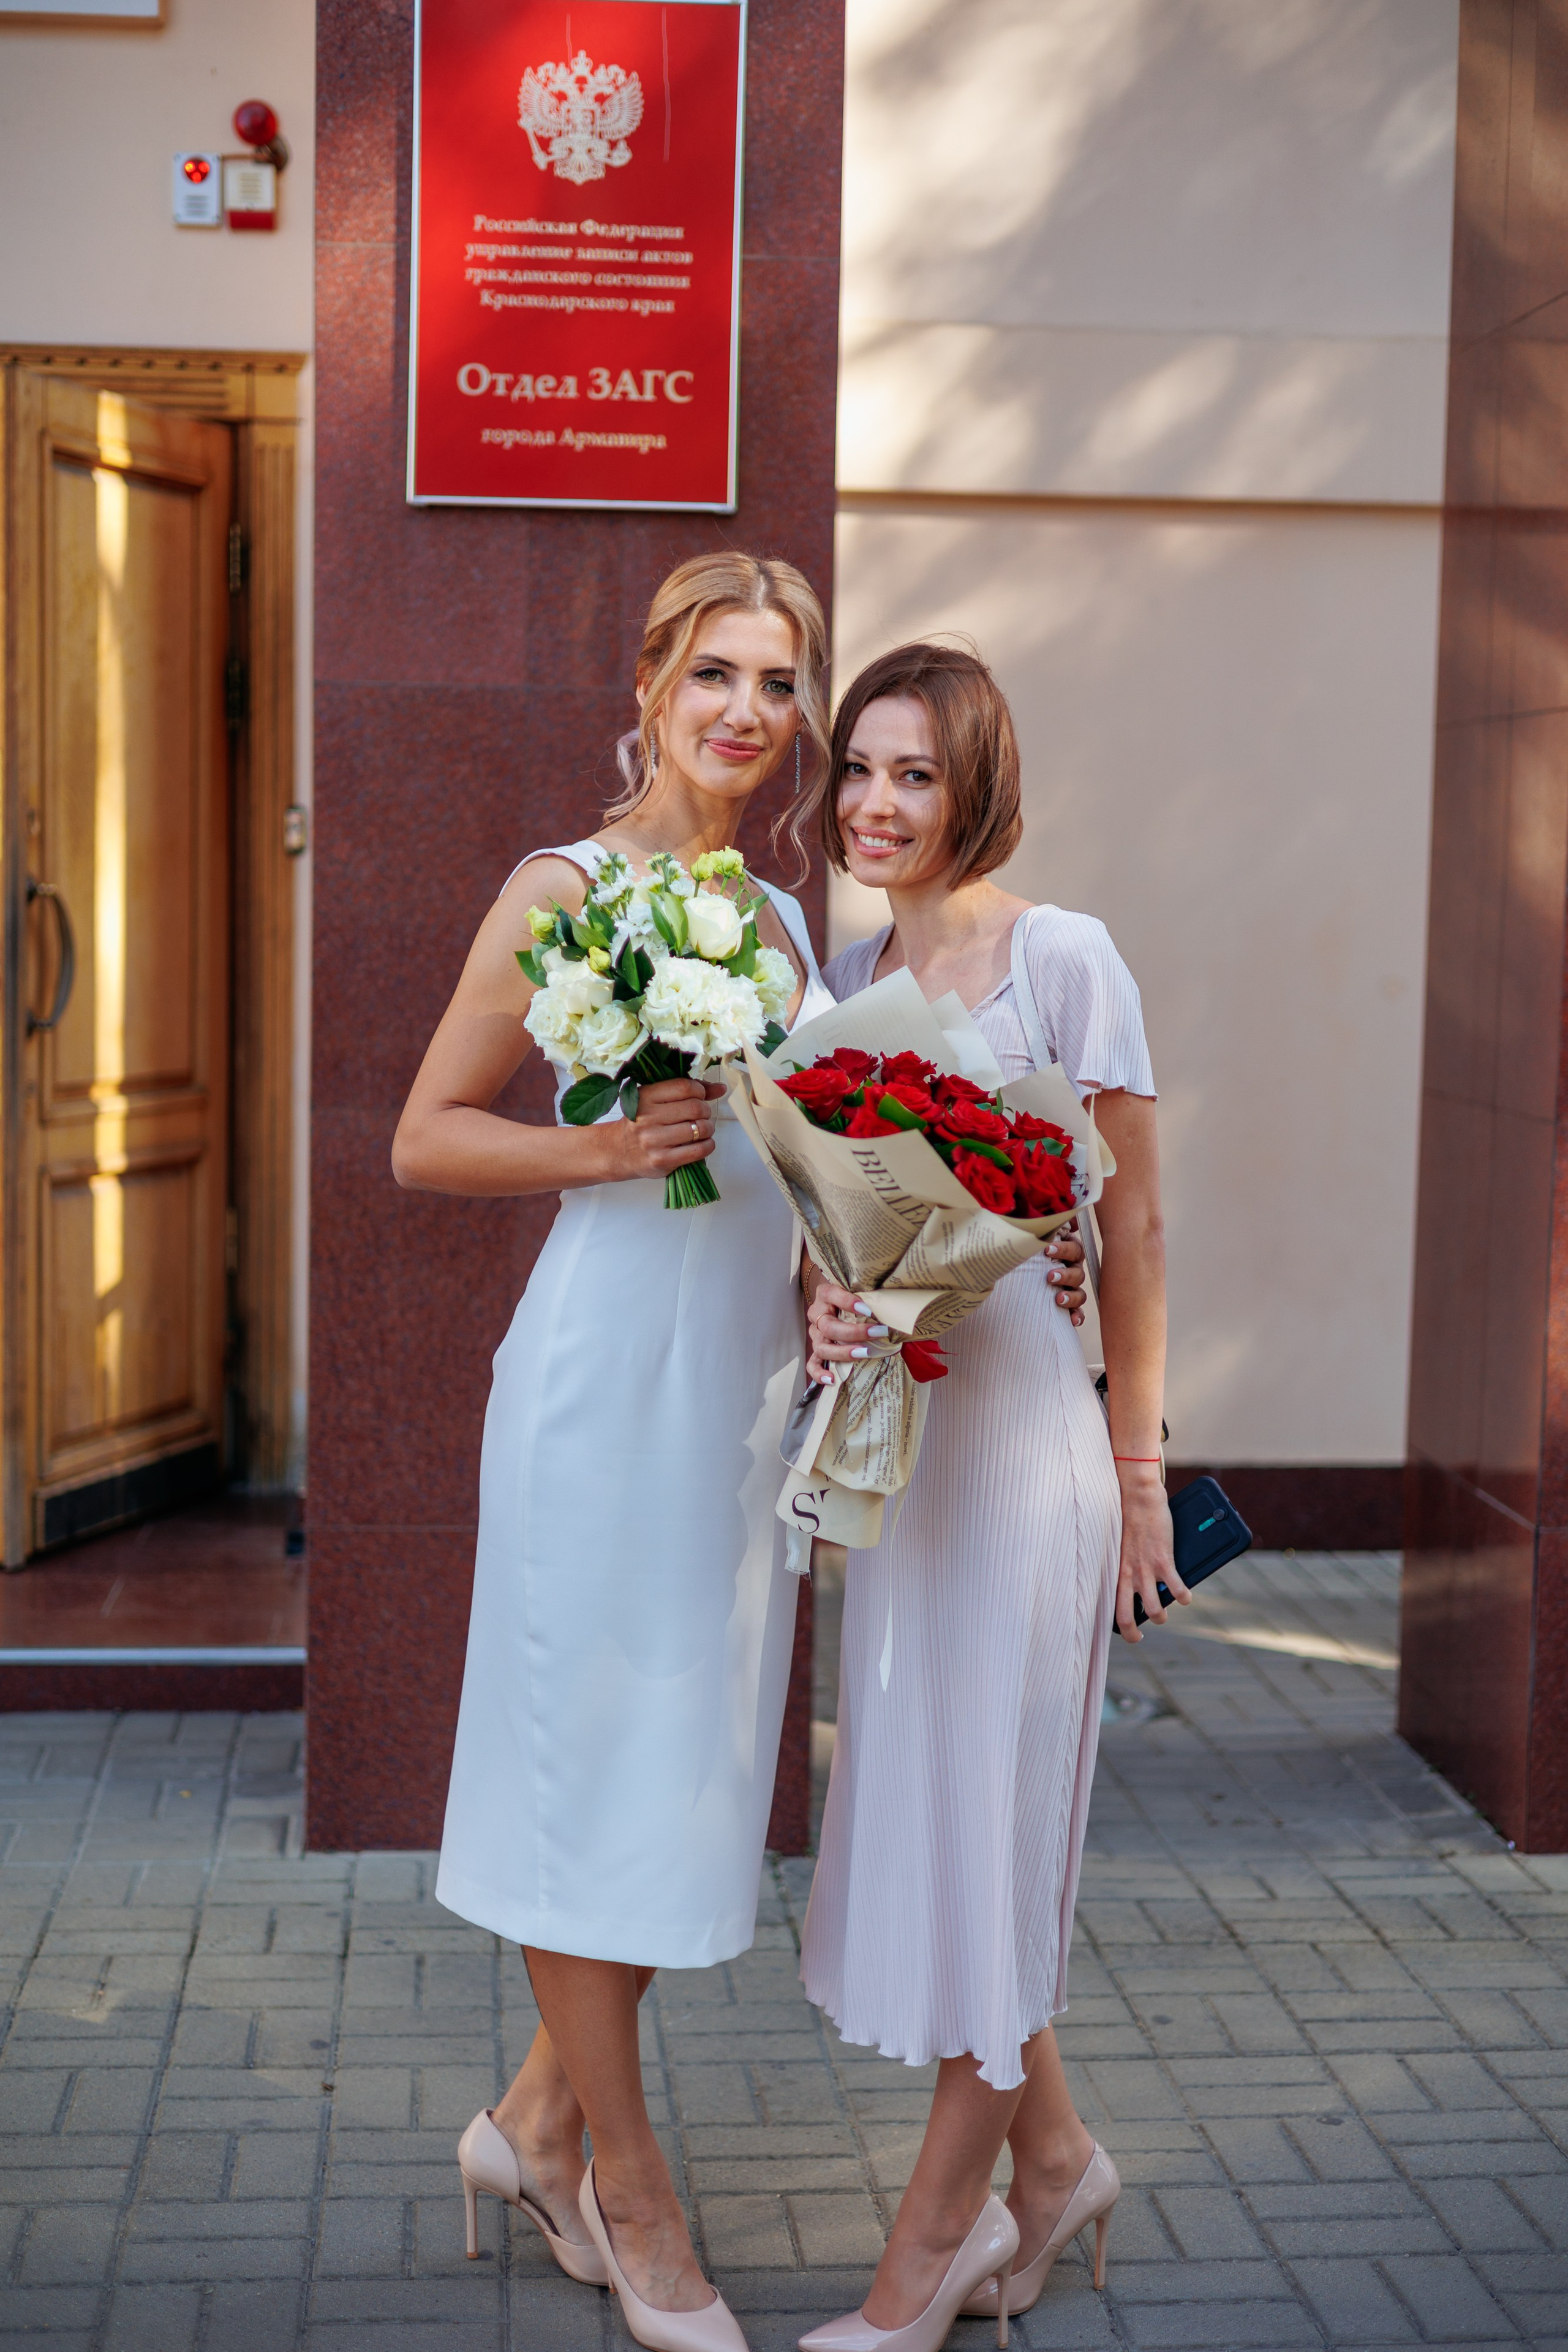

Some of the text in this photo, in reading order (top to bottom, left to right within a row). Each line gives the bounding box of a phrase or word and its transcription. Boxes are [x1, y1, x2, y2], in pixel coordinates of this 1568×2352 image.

[473, 214, 684, 242] Российская Федерация
[464, 243, 693, 264] управление записи актов
[465, 268, 690, 289] гражданского состояния
[480, 289, 675, 317] Краснодарского края
[456, 363, 694, 404] Отдел ЗАГС
[481, 427, 667, 454] города Армавира
